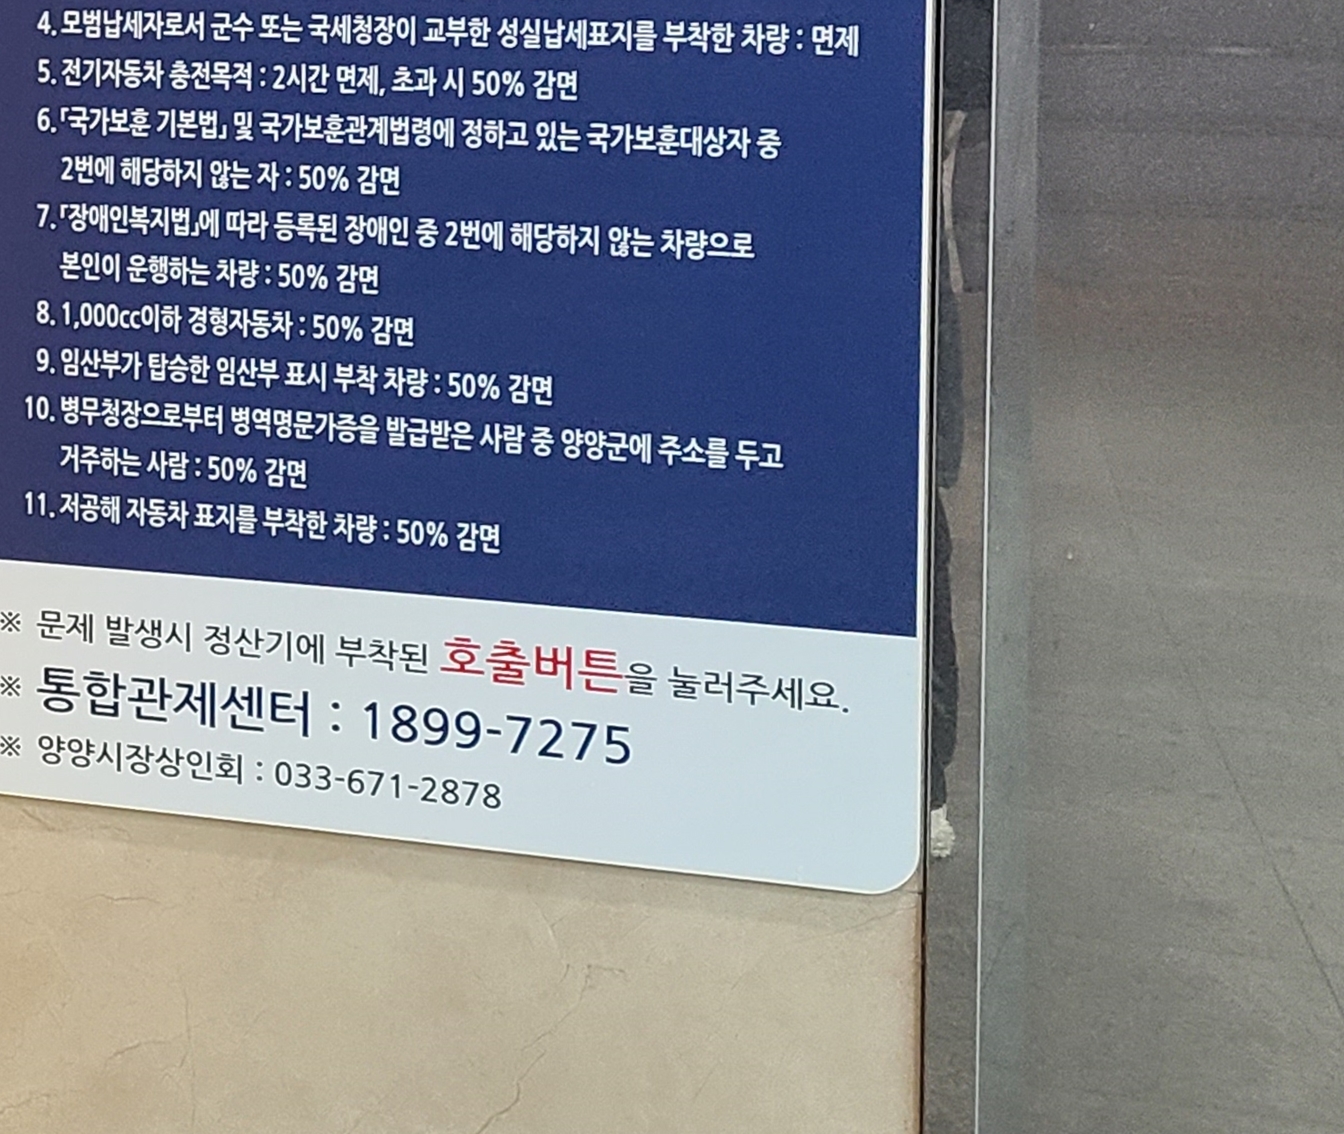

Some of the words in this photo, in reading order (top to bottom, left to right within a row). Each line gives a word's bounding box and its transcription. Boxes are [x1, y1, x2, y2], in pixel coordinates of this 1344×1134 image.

[36, 58, 57, 85] 5.
[60, 56, 165, 89] 전기자동차
[167, 59, 252, 92] 충전목적
[271, 62, 331, 94] 2시간
[335, 63, 386, 97] 면제,
[390, 65, 437, 97] 초과
[442, 66, 464, 98] 시
[471, 69, 525, 97] 50%
[532, 69, 578, 101] 감면
[35, 299, 56, 326] 8.
[61, 300, 183, 334] 1,000cc이하
[187, 305, 294, 341] 경형자동차
[311, 313, 363, 342] 50%
[370, 315, 414, 347] 감면
[60, 395, 223, 435] 병무청장으로부터
[230, 405, 380, 445] 병역명문가증을
[385, 415, 474, 451] 발급받은
[478, 422, 526, 455] 사람
[529, 425, 555, 457] 중
[560, 427, 652, 464] 양양군에
[656, 434, 730, 469] 주소를
[734, 439, 784, 471] 두고
[35, 609, 93, 644] 문제
[105, 614, 191, 653] 발생시
[203, 624, 324, 665] 정산기에
[334, 634, 428, 674] 부착된
[439, 636, 658, 696] 호출버튼을
[666, 665, 849, 713] 눌러주세요.
[36, 666, 309, 738] 통합관제센터
[363, 700, 631, 764] 1899-7275
[37, 734, 242, 785] 양양시장상인회
[274, 760, 502, 809] 033-671-2878
